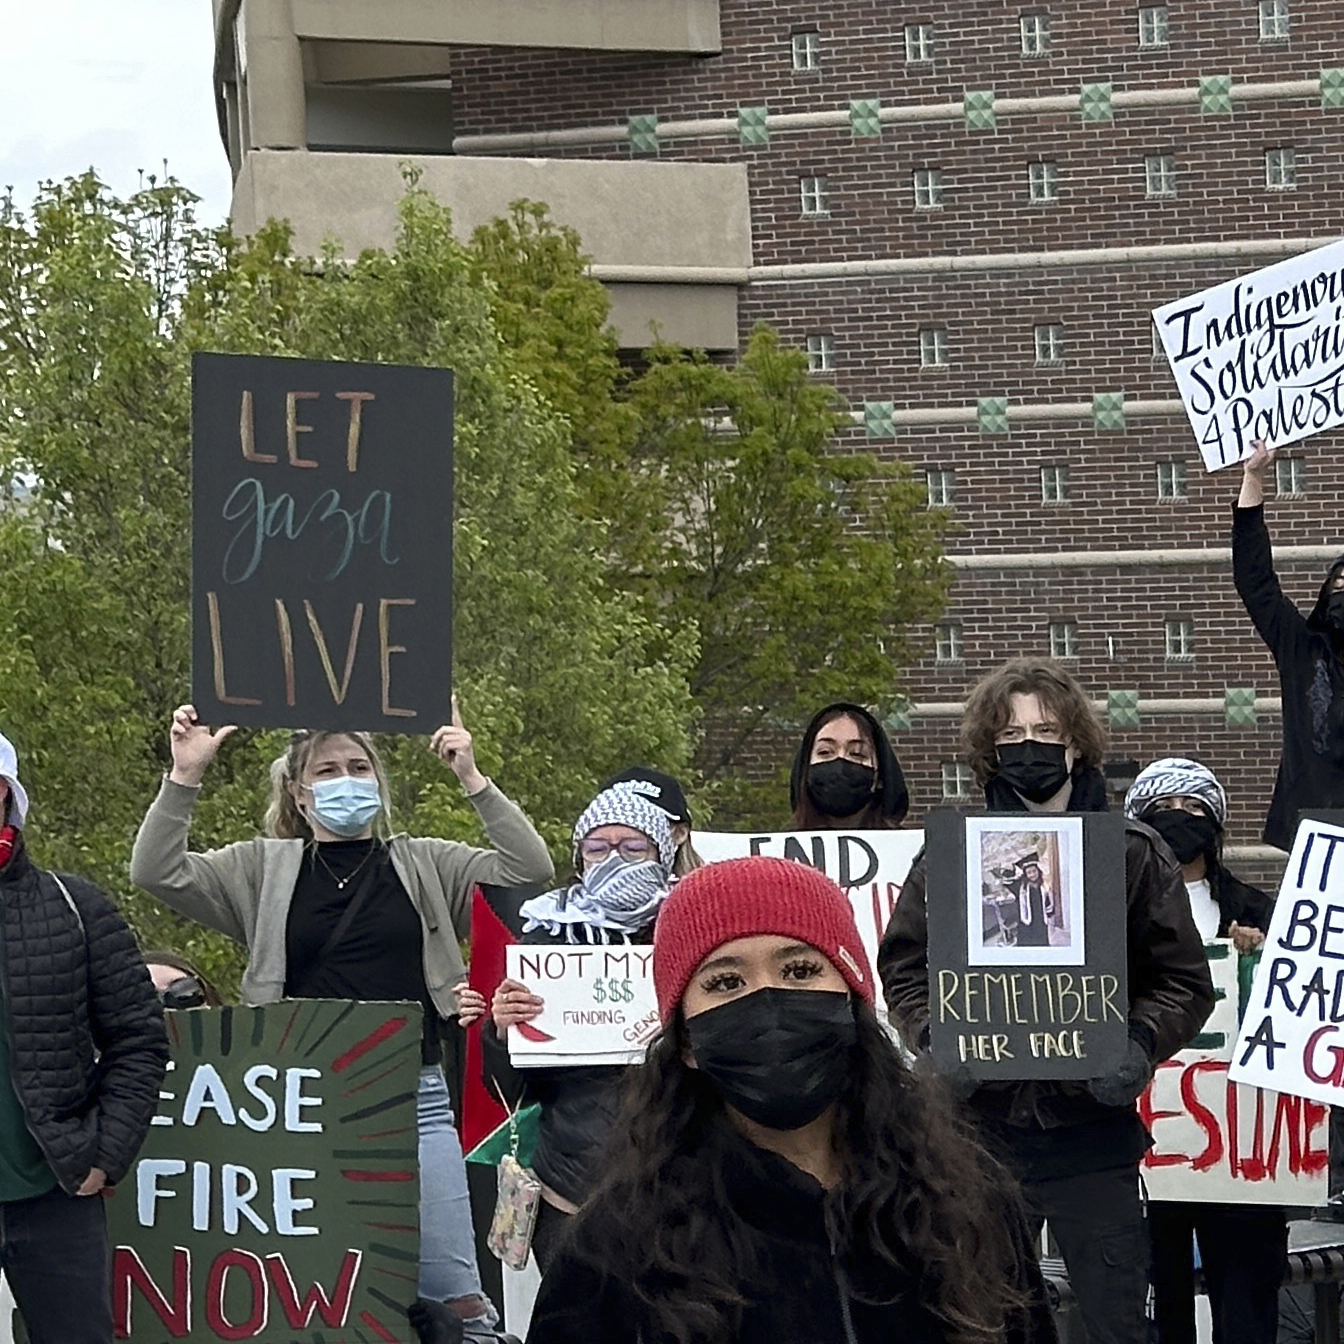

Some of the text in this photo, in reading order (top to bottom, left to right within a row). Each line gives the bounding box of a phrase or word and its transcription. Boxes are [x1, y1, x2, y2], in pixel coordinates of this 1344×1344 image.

[239, 390, 376, 472] LET
[1202, 414, 1226, 464] 4
[222, 477, 400, 585] gaza
[207, 591, 417, 718] LIVE
[519, 951, 654, 980] NOT MY
[562, 1009, 626, 1025] FUNDING
[938, 968, 1126, 1026] REMEMBER
[622, 1009, 660, 1043] GENO
[957, 1029, 1088, 1063] HER FACE
[1238, 1014, 1287, 1071] A
[135, 1158, 321, 1236] FIRE
[113, 1245, 363, 1340] NOW
